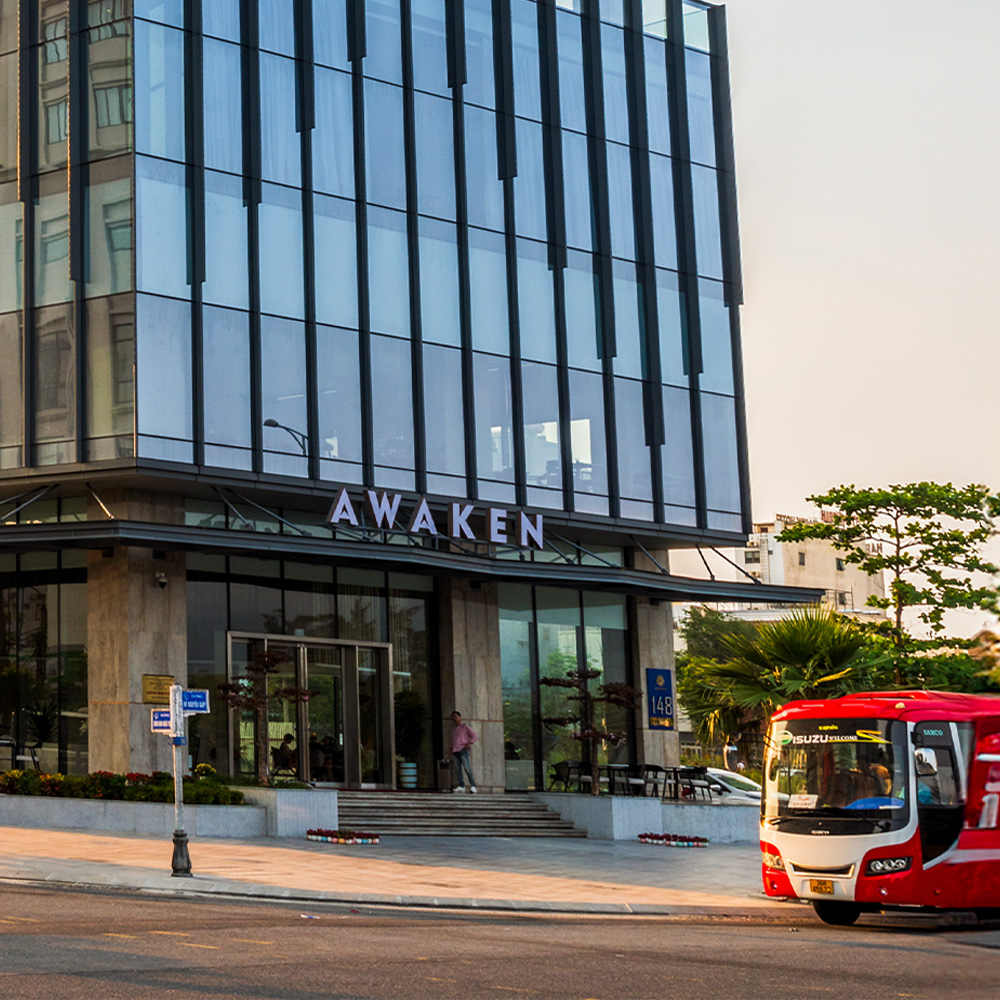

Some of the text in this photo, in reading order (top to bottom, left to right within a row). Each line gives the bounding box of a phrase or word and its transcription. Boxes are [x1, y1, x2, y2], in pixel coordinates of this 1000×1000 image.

[329, 486, 544, 550] AWAKEN
[652, 695, 673, 716] 148
[792, 734, 829, 745] ISUZU
